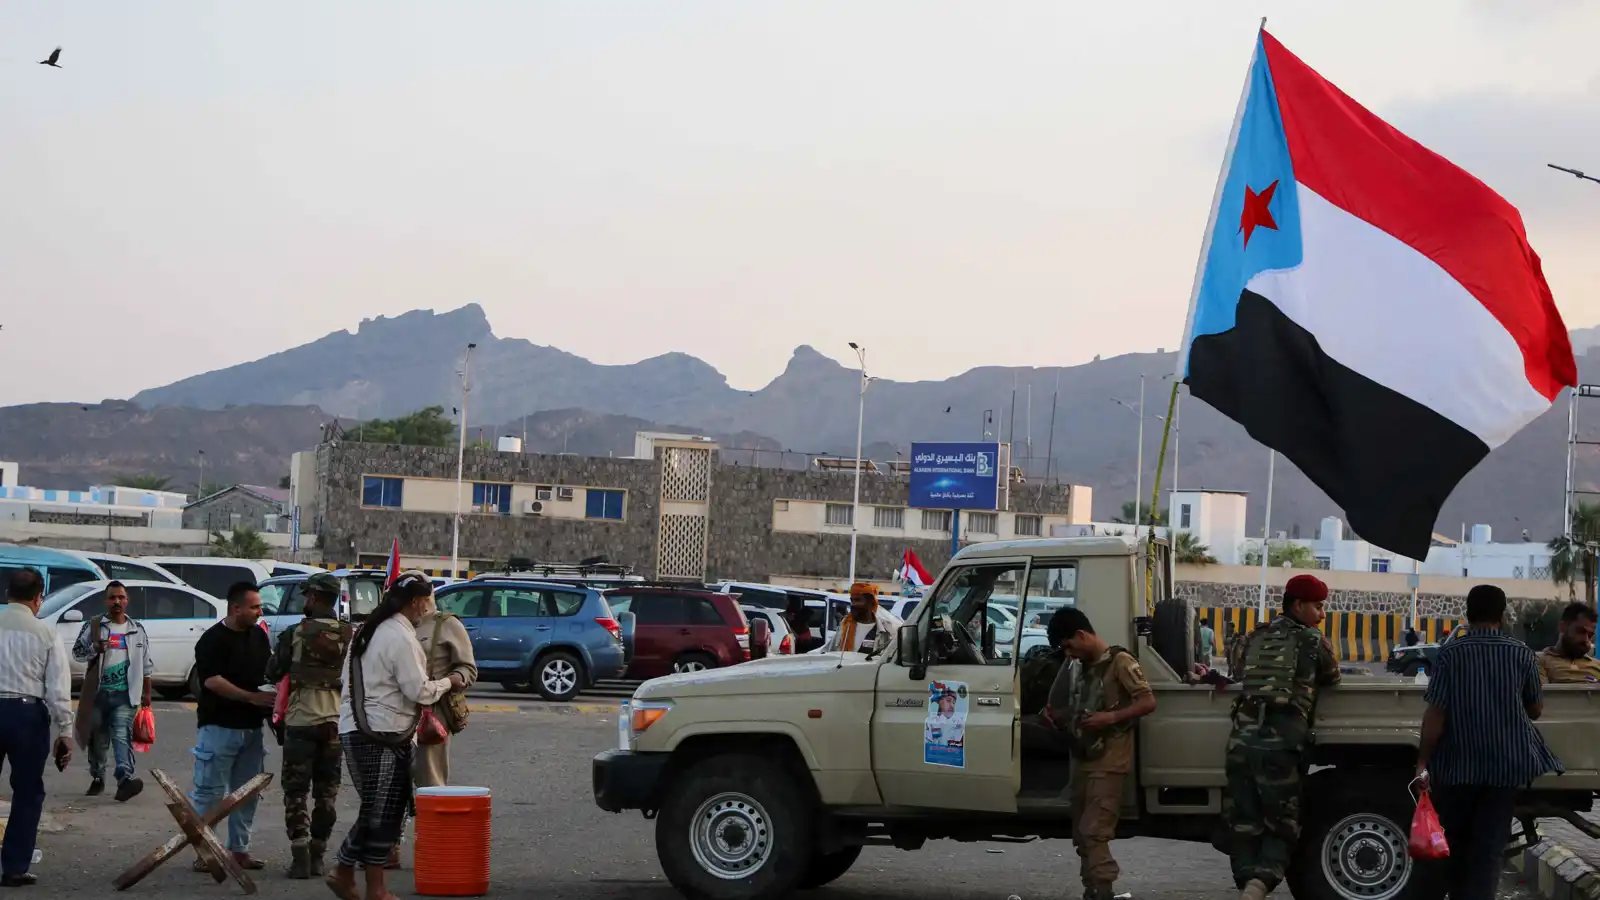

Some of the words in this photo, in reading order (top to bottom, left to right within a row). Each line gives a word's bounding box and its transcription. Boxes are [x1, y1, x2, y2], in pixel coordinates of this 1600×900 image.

[915, 453, 935, 464] الدولي
[936, 453, 963, 465] البسيري
[965, 453, 976, 464] بنك
